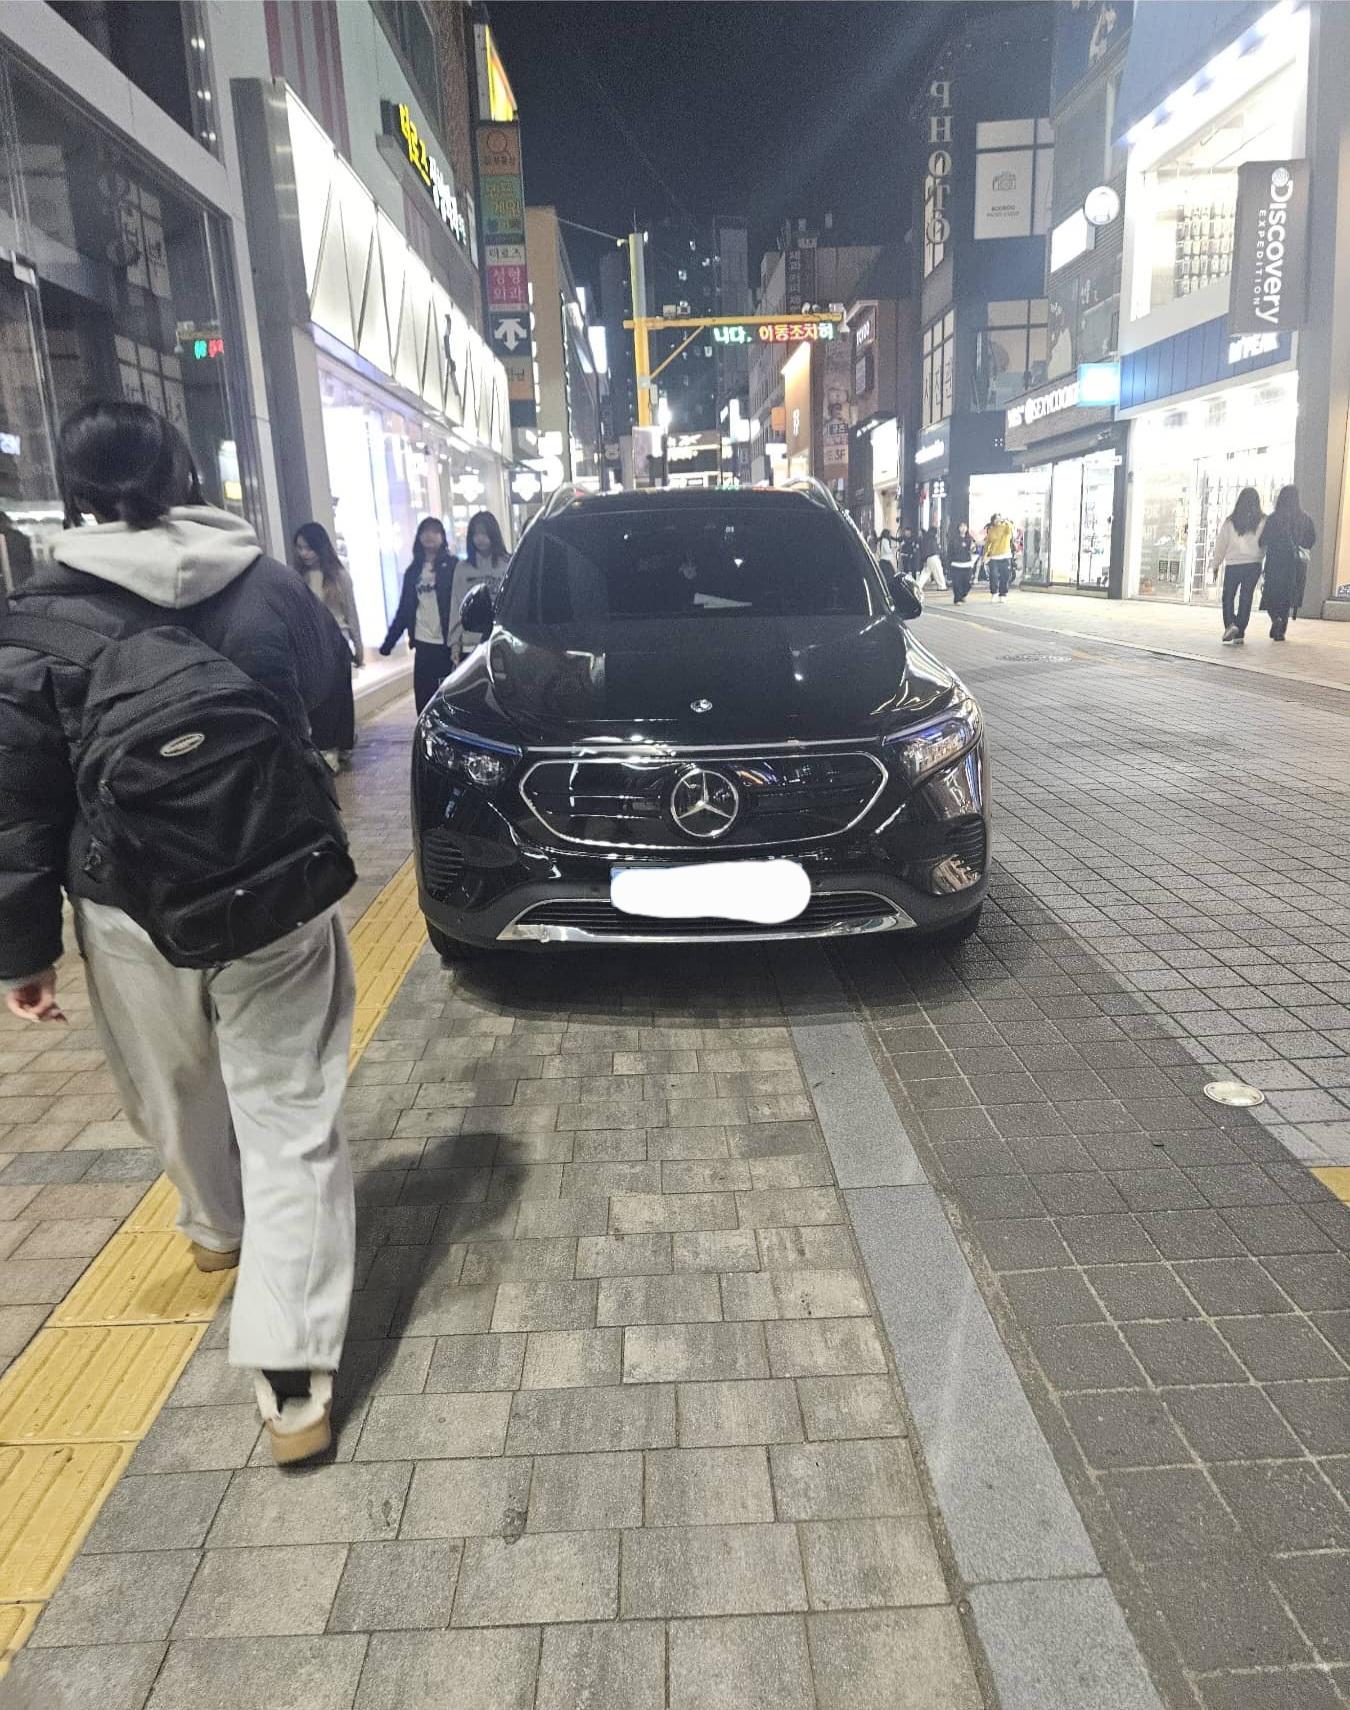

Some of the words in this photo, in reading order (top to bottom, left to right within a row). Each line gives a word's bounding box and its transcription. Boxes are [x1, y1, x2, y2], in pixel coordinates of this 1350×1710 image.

[1252, 209, 1267, 305] EXPEDITION
[490, 267, 520, 285] 성형
[493, 286, 522, 301] 외과
[713, 325, 752, 344] 니다.
